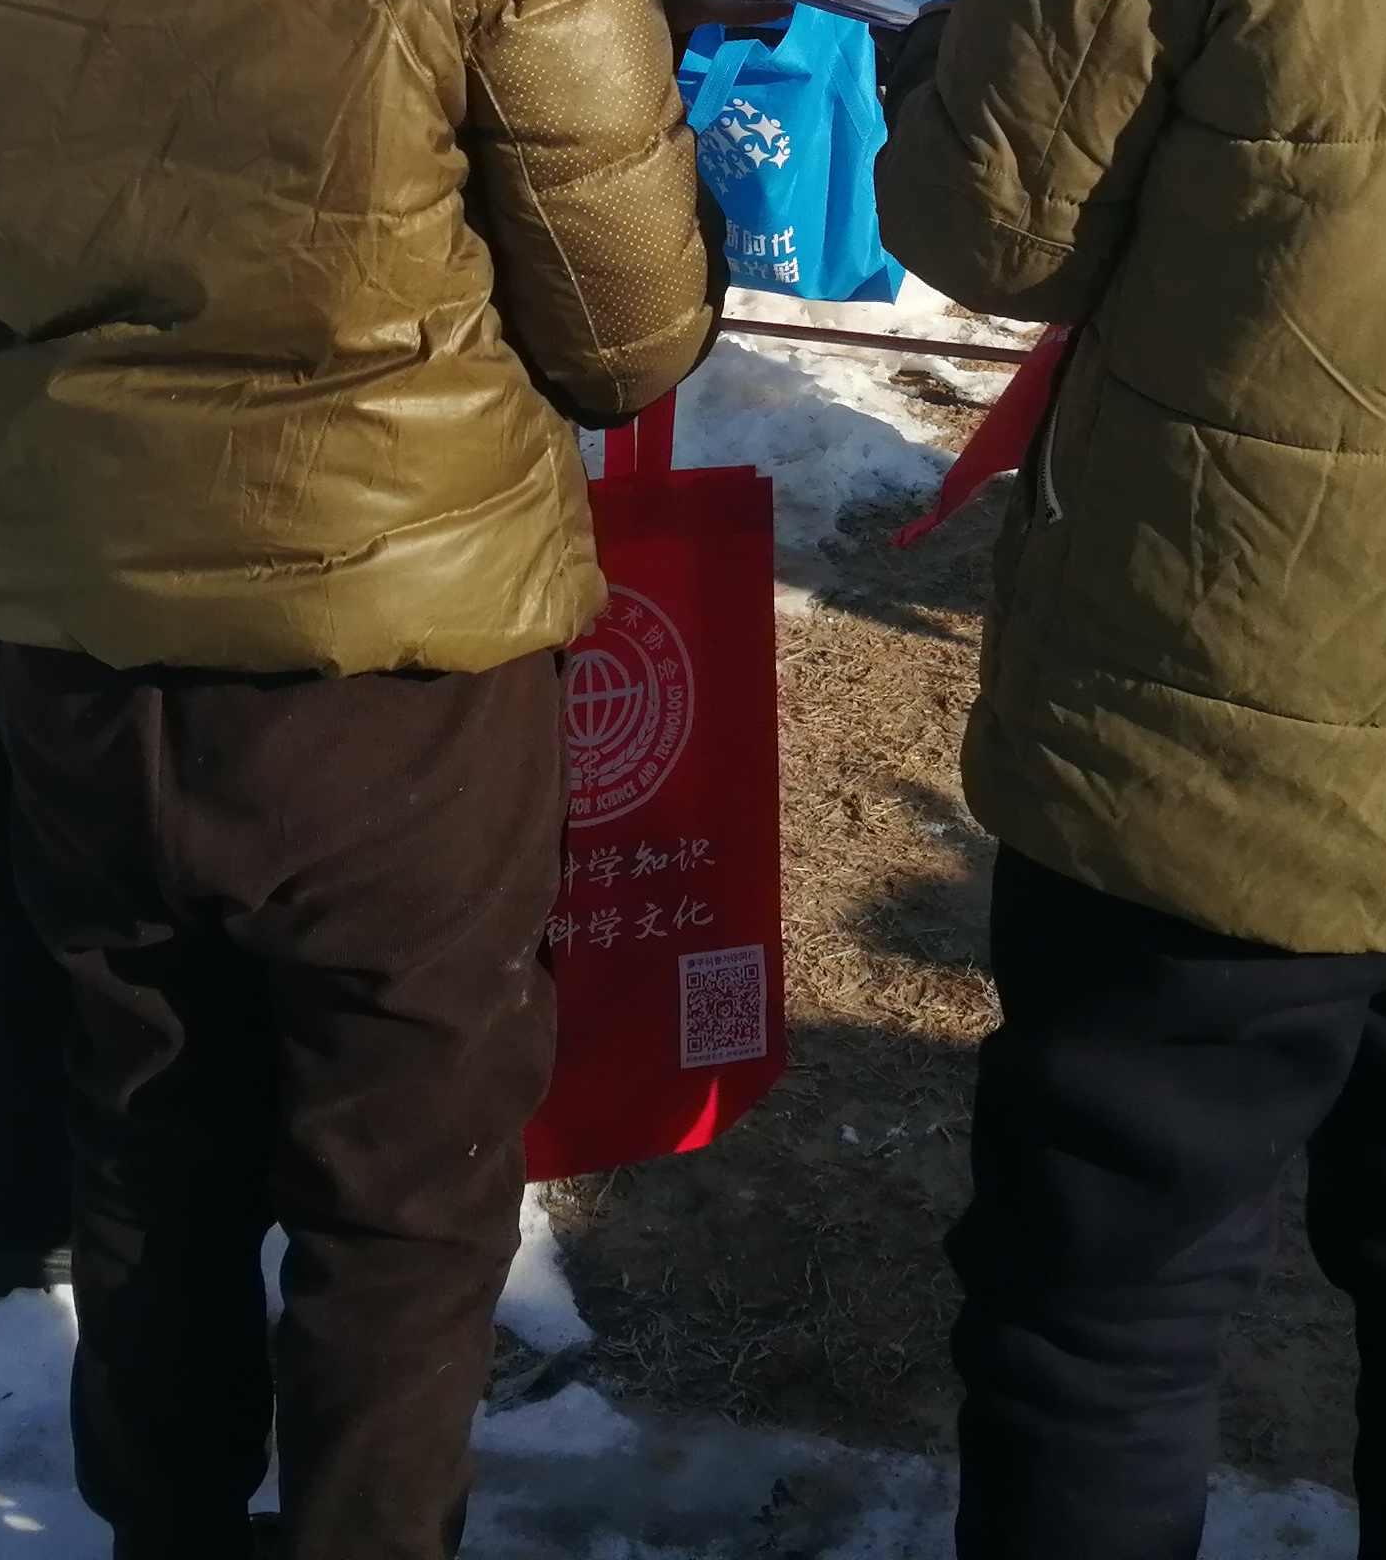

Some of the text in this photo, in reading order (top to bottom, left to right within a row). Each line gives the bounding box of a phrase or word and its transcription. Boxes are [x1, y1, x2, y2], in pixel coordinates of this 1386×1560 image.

[596, 780, 639, 813] SCIENCE
[638, 760, 660, 786] AND
[653, 685, 683, 760] TECHNOLOGY
[545, 895, 714, 957] 科学文化
